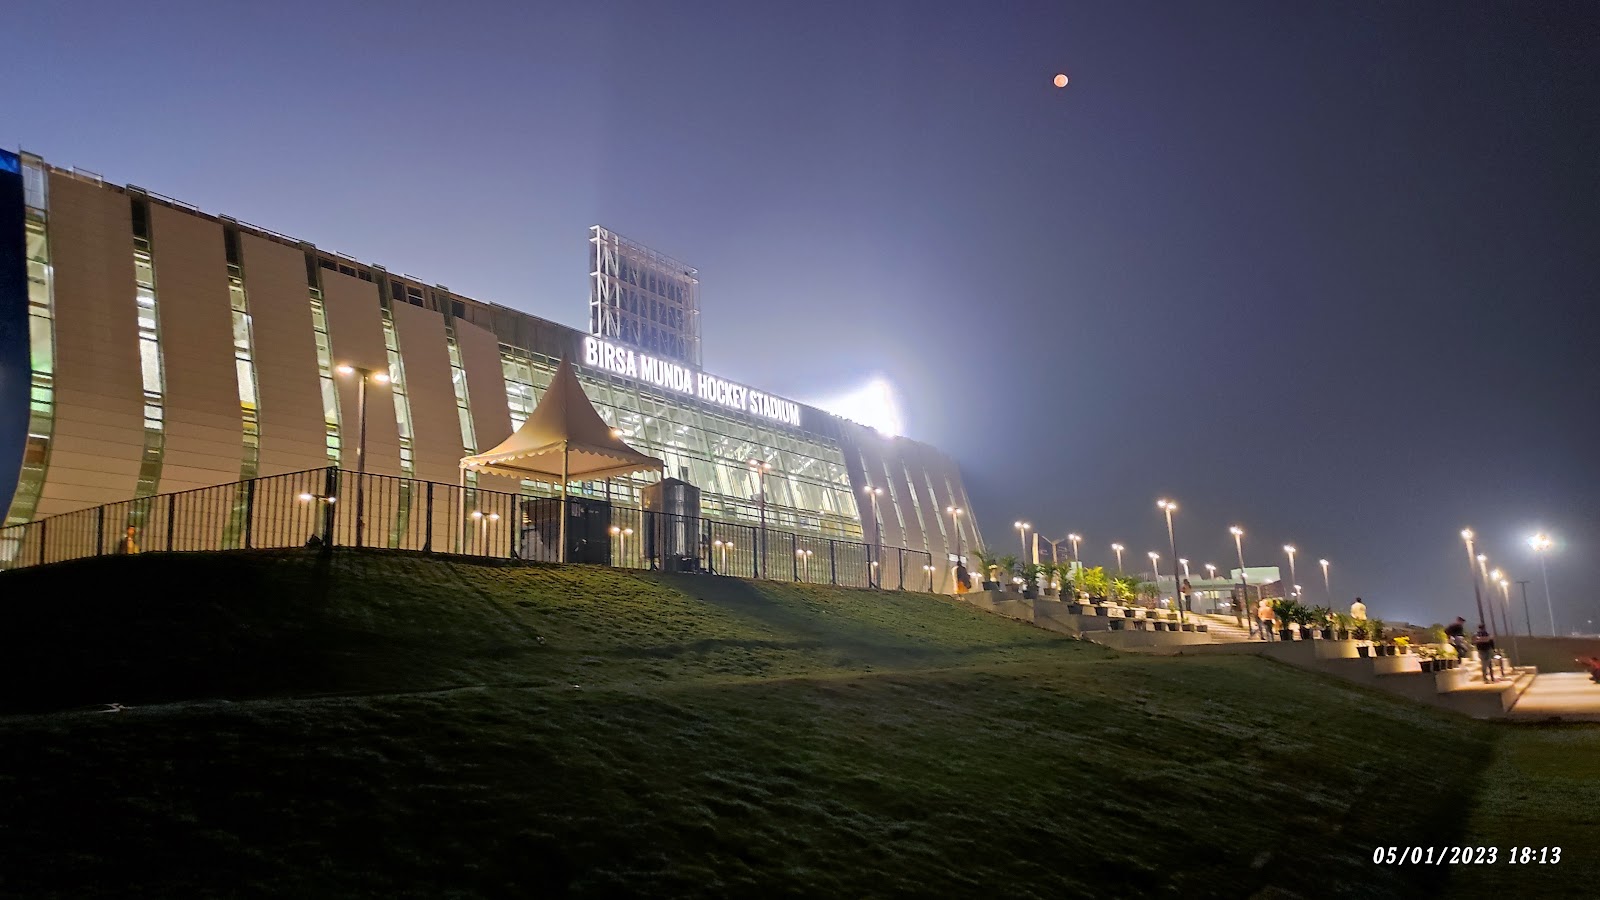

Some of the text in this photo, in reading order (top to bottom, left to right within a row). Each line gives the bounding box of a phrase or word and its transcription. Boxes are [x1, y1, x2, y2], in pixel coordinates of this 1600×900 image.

[585, 336, 800, 426] BIRSA MUNDA HOCKEY STADIUM
